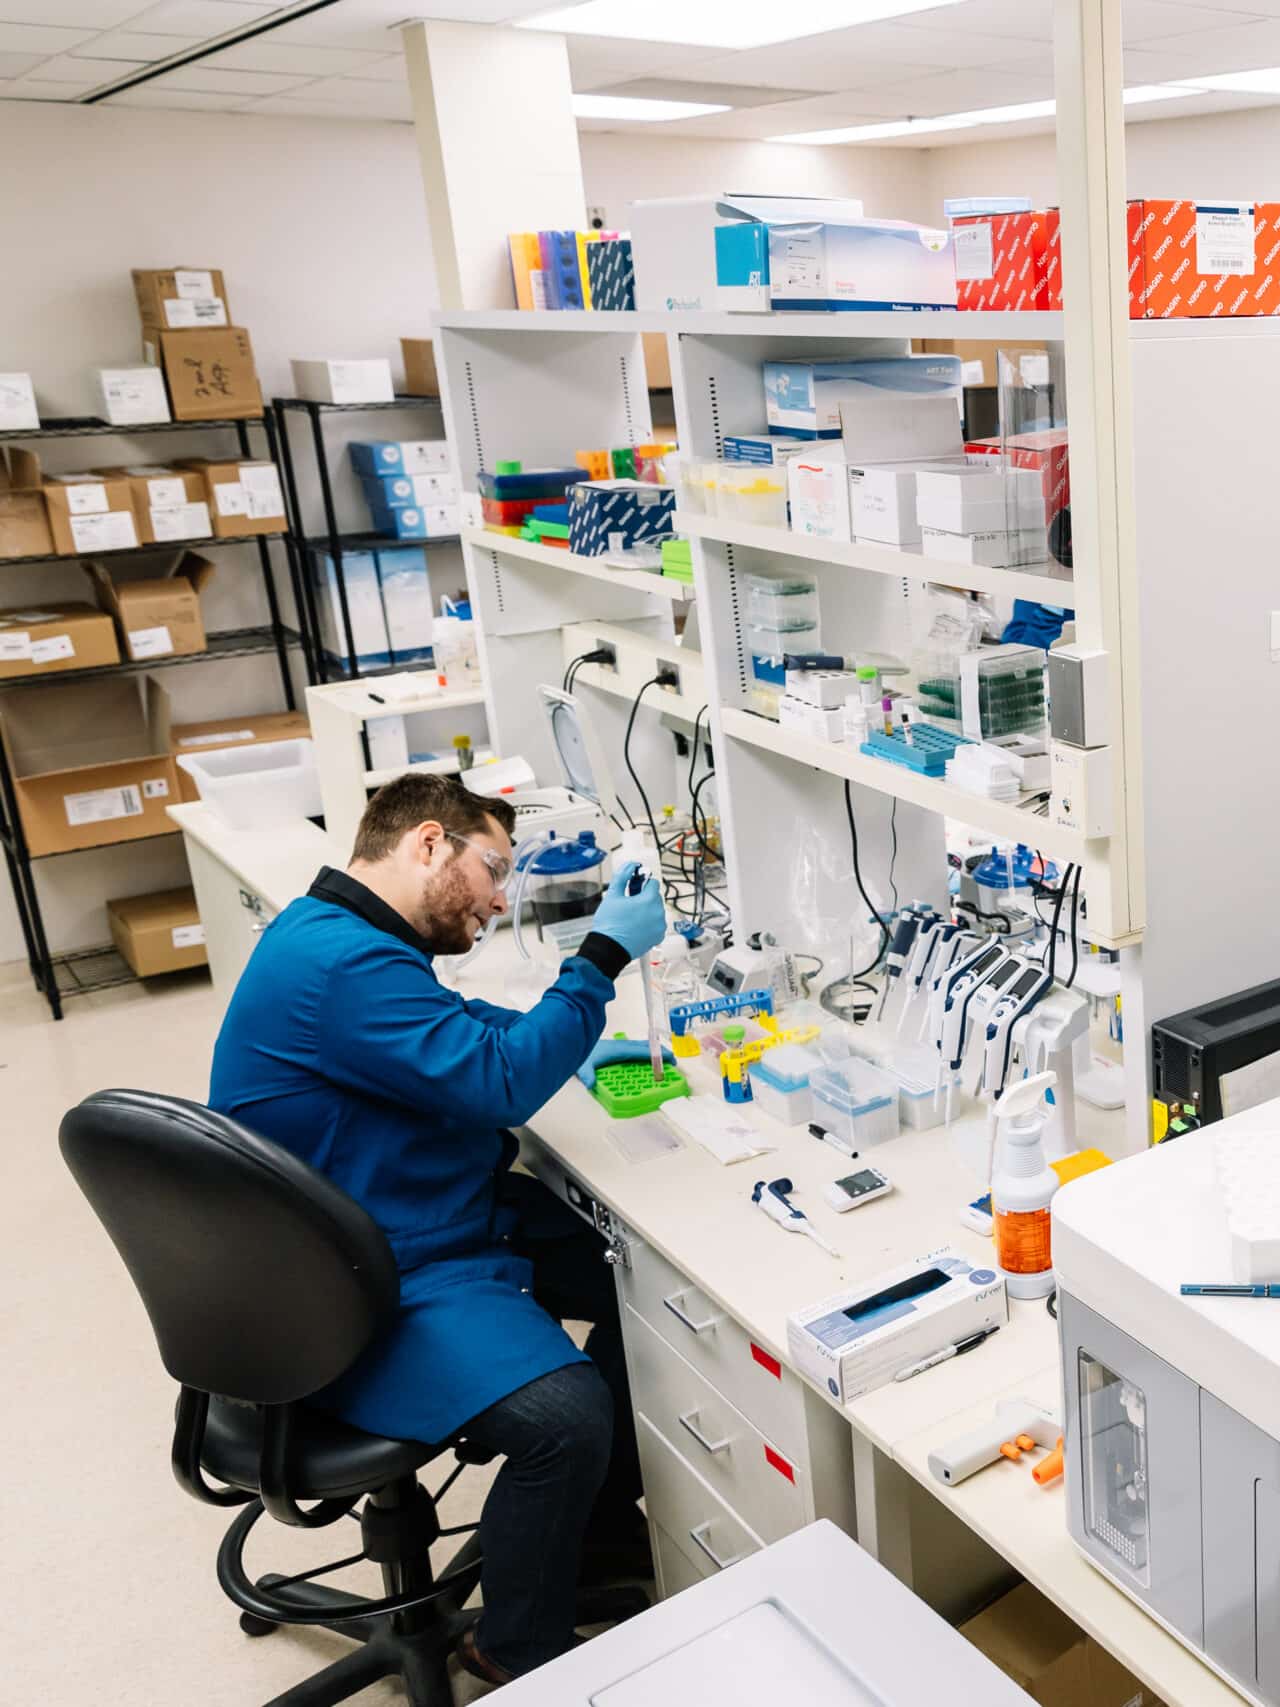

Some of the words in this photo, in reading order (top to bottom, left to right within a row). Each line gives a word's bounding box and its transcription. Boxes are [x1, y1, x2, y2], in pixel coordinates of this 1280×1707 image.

[1152, 235, 1173, 263] QIAGEN
[1170, 258, 1191, 285] QIAGEN
[1187, 280, 1207, 306] QIAGEN
